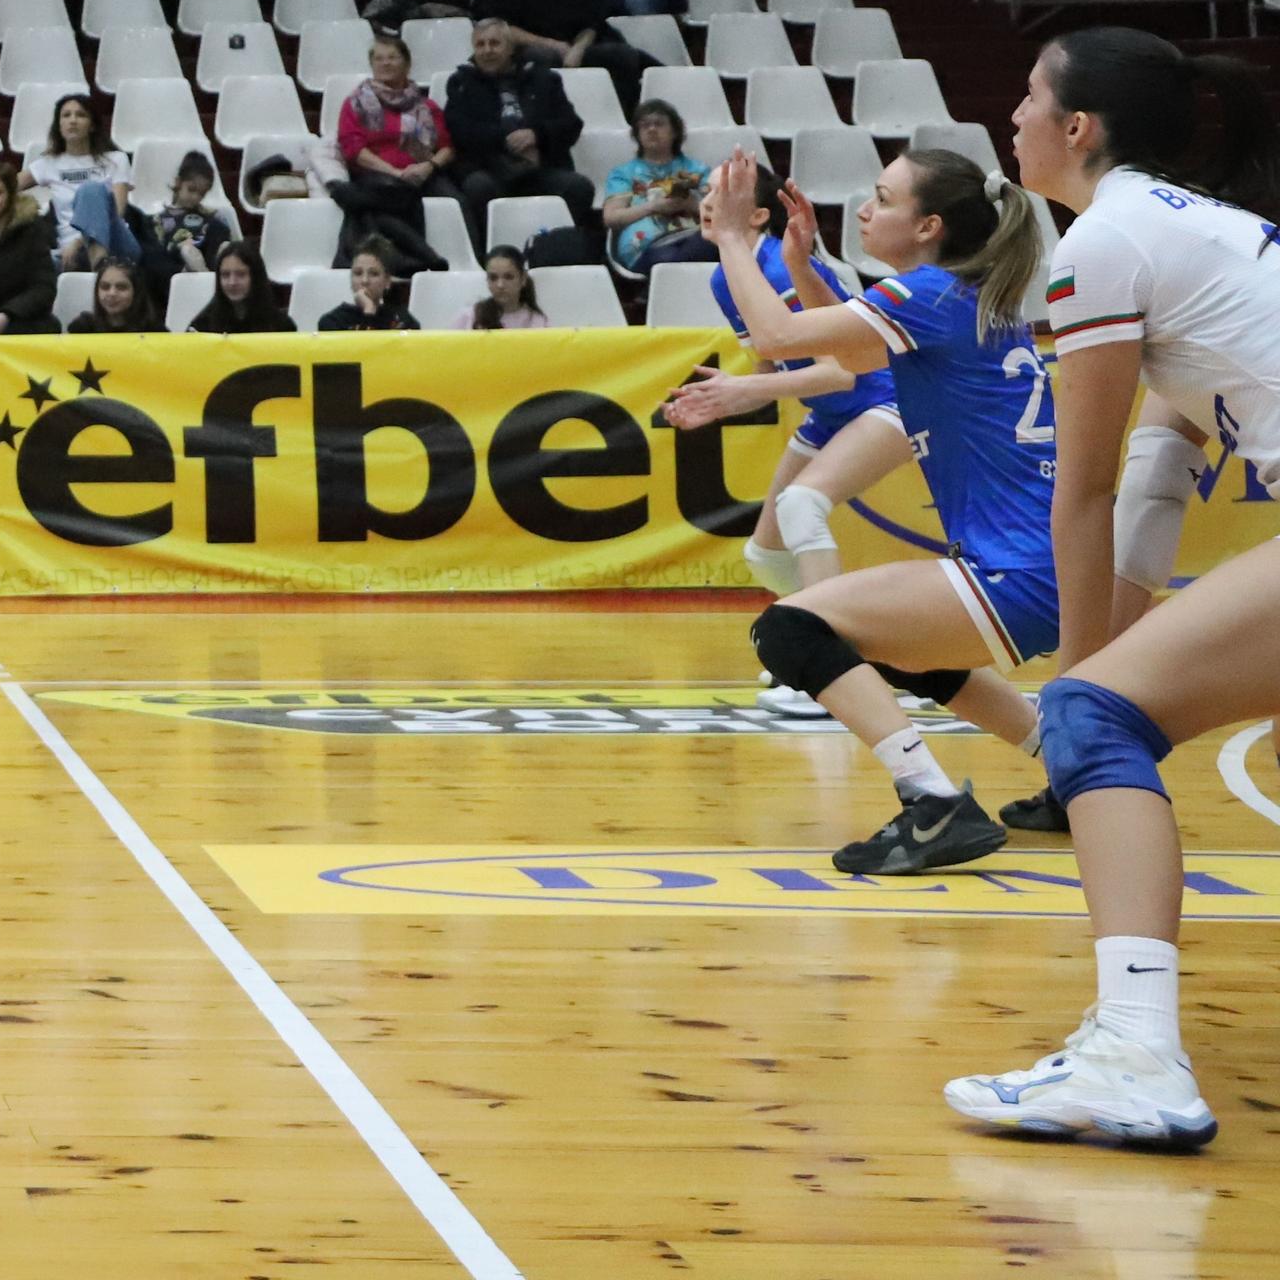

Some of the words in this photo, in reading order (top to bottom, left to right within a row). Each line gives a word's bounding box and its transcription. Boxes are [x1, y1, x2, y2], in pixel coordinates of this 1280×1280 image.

[16, 353, 778, 547] efbet
[129, 566, 210, 590] НОСИ
[222, 566, 297, 591] РИСК
[536, 563, 578, 588] НА
